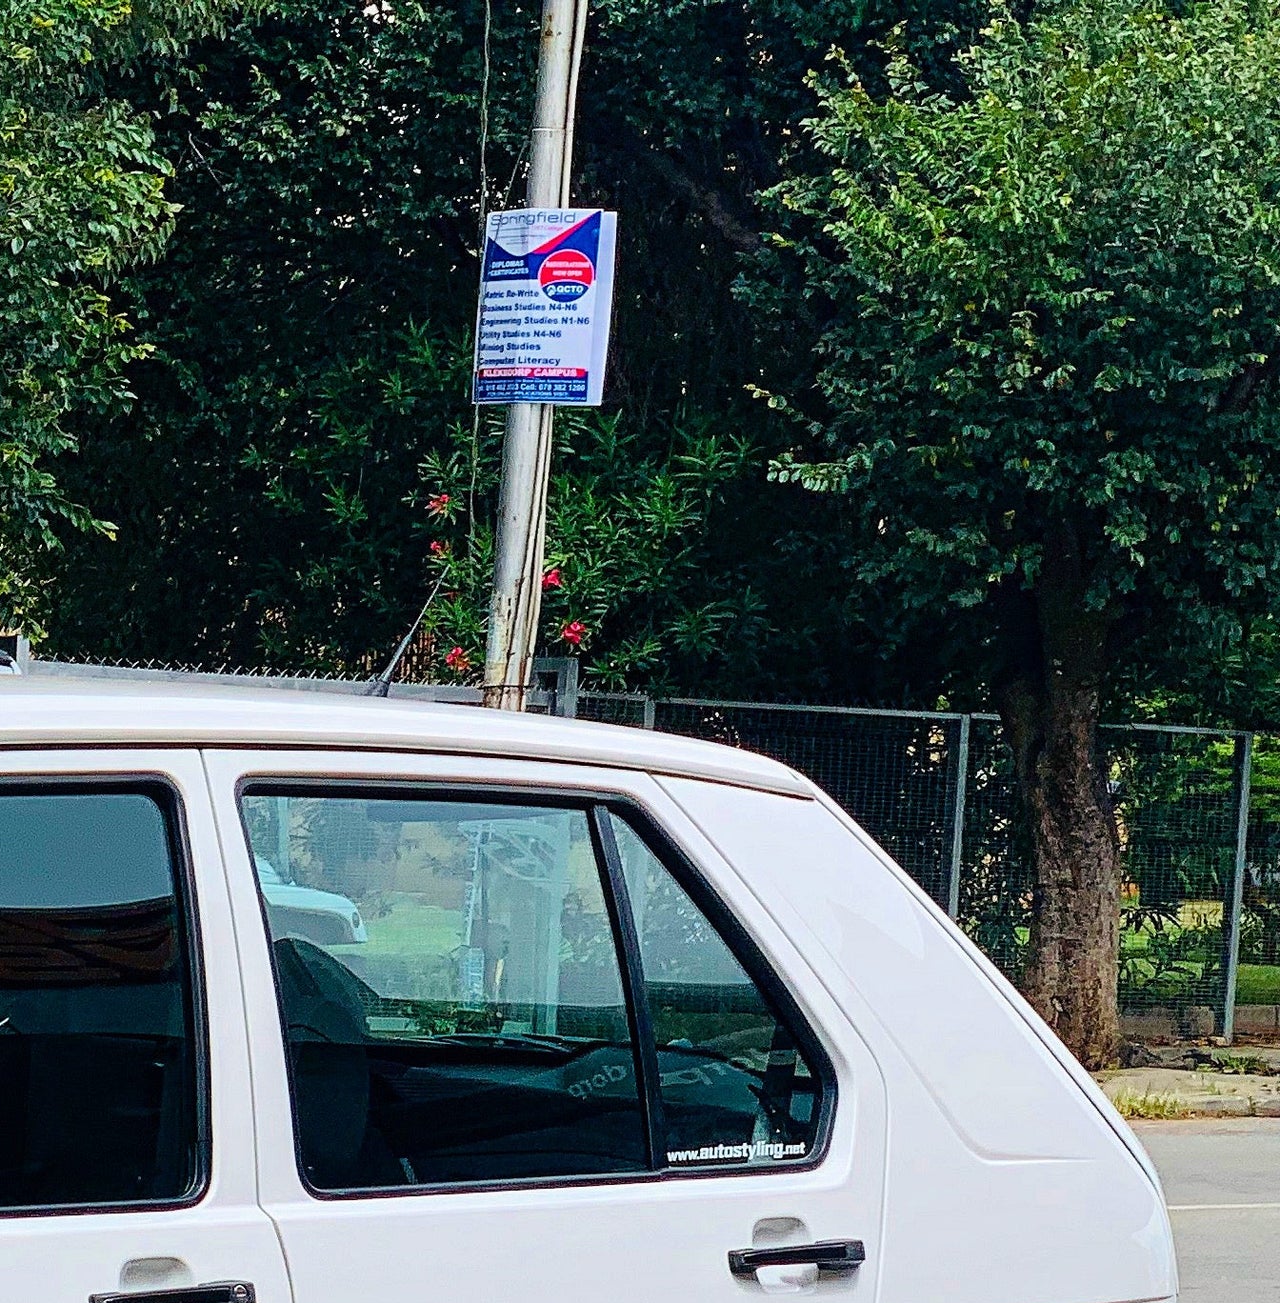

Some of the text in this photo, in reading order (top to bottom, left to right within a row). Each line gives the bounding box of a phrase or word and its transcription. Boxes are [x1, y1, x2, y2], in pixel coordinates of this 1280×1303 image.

[490, 211, 577, 226] Springfield
[556, 285, 584, 294] QCTO
[514, 303, 546, 311] Studies
[549, 303, 578, 311] N4-N6
[524, 316, 558, 325] Studies
[561, 317, 590, 325] N1-N6
[502, 330, 531, 339] Studies
[533, 330, 562, 338] N4-N6
[506, 342, 541, 351] Studies
[517, 356, 561, 366] Literacy
[666, 1140, 806, 1162] www.autostyling.net
